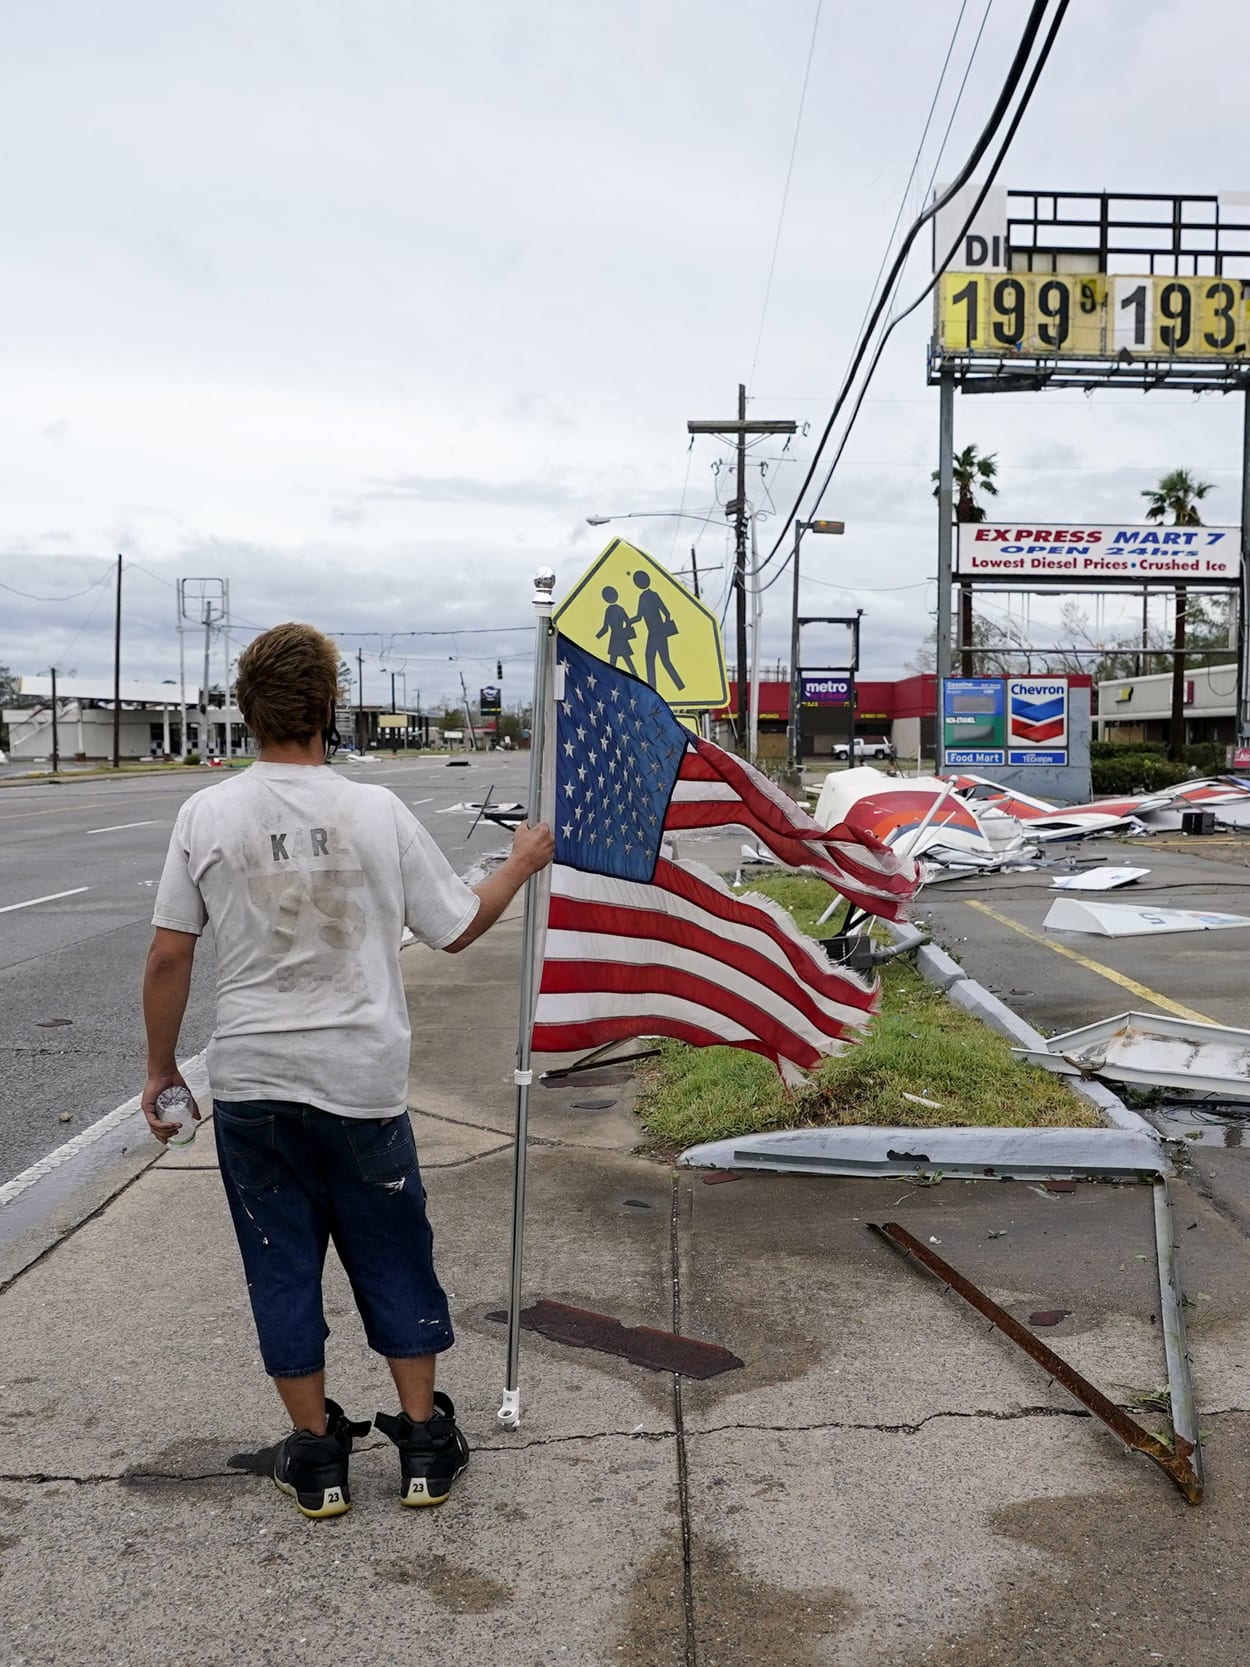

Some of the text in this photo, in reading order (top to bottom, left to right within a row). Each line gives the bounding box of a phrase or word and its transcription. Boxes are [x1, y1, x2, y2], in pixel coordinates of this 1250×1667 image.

[974, 528, 1227, 546] EXPRESS MART 7
[999, 545, 1200, 557] OPEN 24hrs
[972, 556, 1227, 572] Lowest Diesel Prices Crushed Ice
[805, 681, 848, 696] metro
[1011, 683, 1065, 696] Chevron
[950, 752, 1000, 763] Food Mart
[412, 1483, 425, 1494] 23
[327, 1492, 340, 1504] 23
